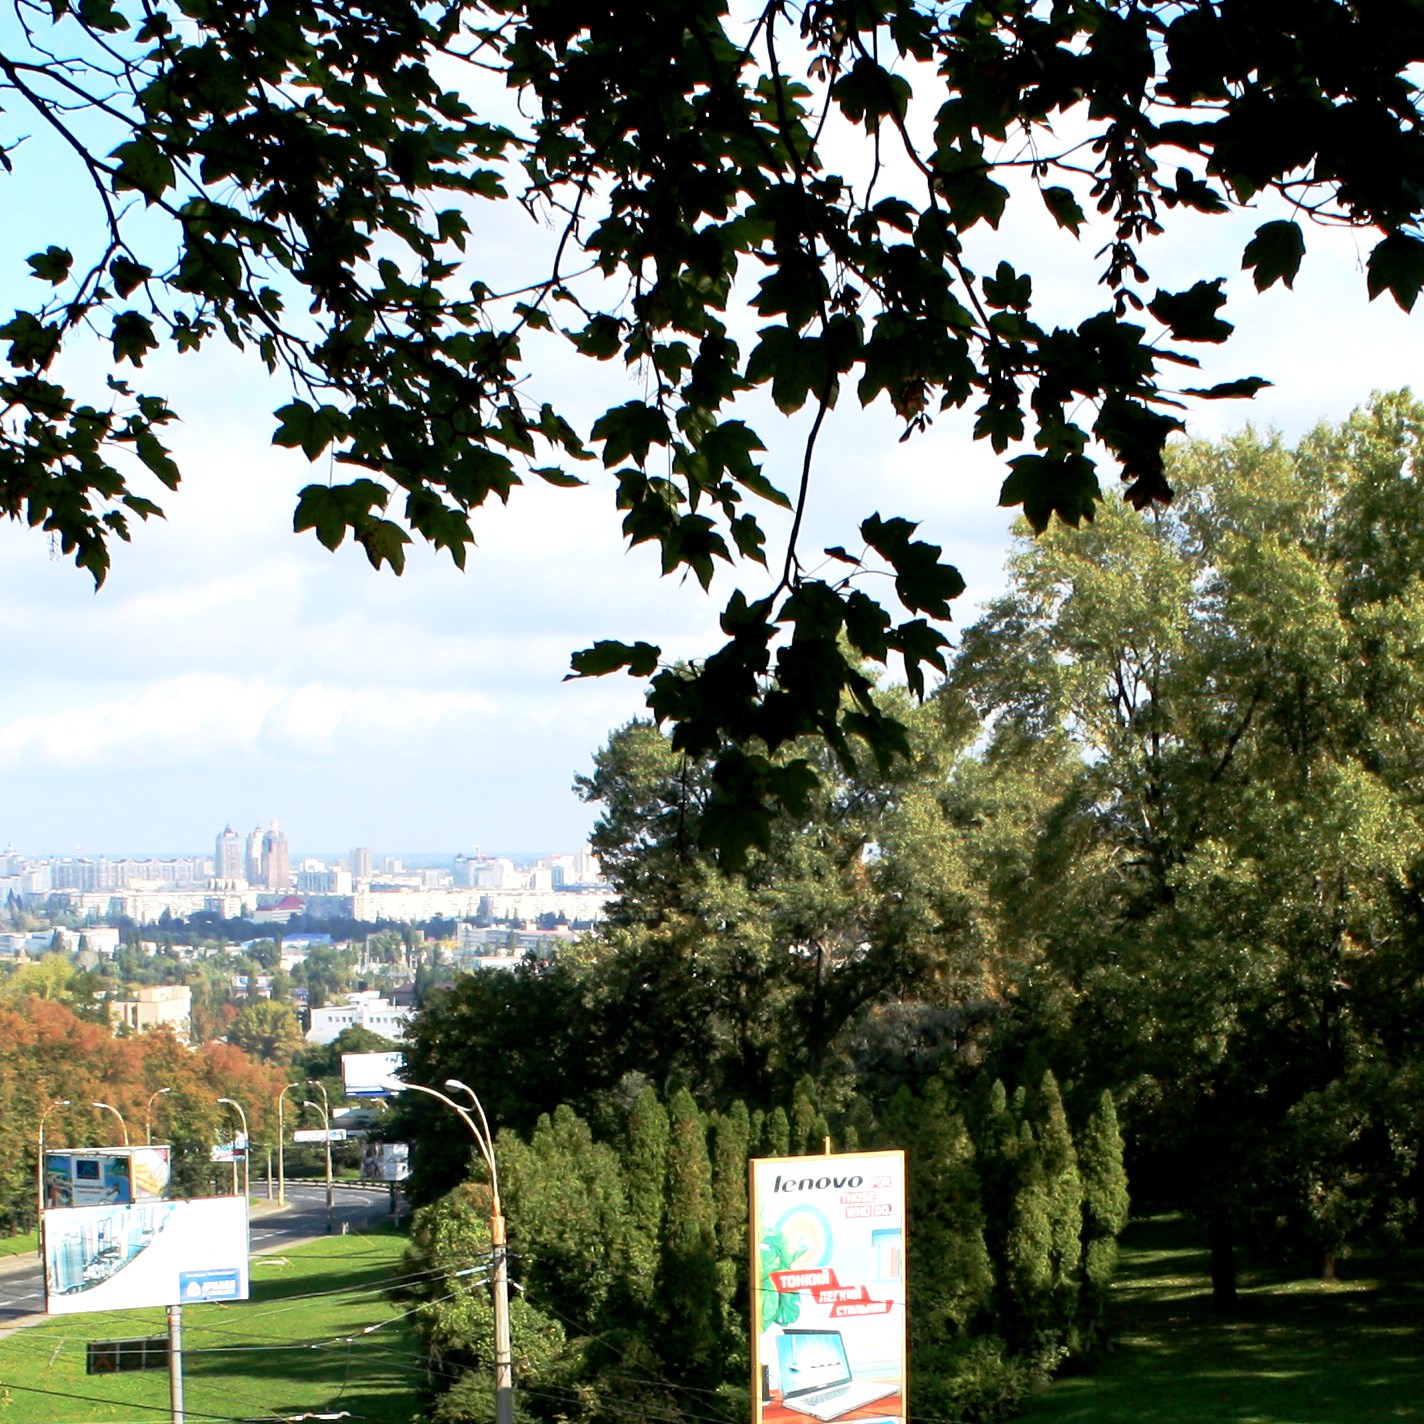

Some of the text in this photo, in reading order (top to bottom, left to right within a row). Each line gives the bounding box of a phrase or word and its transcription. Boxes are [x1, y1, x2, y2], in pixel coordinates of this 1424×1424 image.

[774, 1175, 863, 1193] lenovo
[780, 1268, 830, 1288] ТОНКИЙ
[819, 1286, 862, 1303] ЛЕГКИЙ
